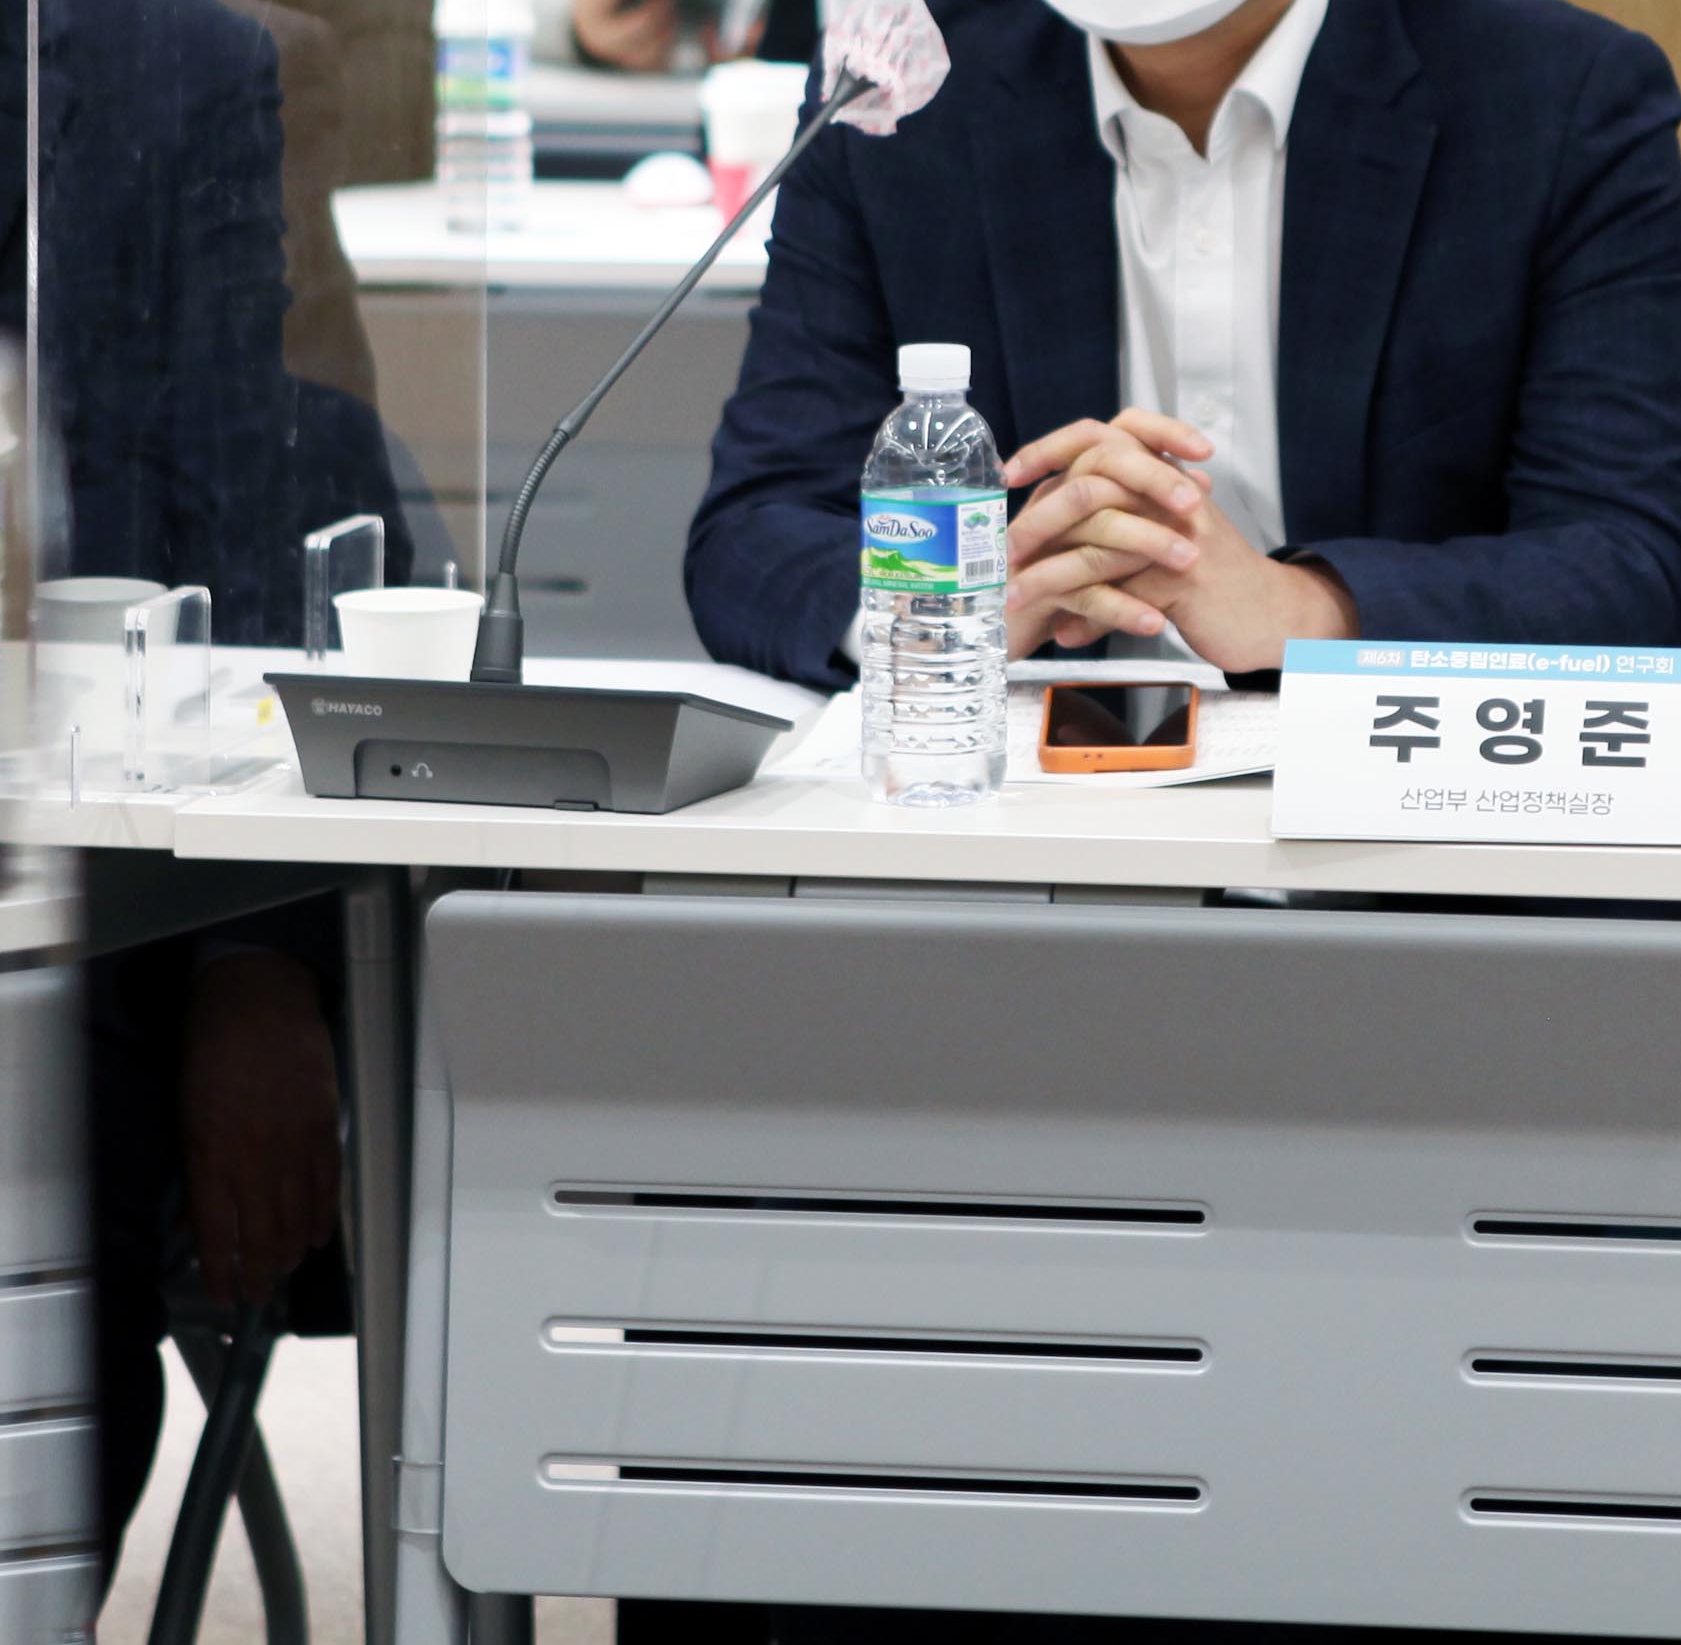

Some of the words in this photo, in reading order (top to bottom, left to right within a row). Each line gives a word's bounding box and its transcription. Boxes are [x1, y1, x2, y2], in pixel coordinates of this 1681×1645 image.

[867, 519, 933, 539] SamDaSoo
[1410, 649, 1611, 674] 탄소중립연료(e-fuel)
[1616, 655, 1675, 675] 연구회
[328, 701, 382, 717] HAYACO
[1400, 788, 1468, 812] 산업부
[1475, 790, 1615, 816] 산업정책실장
